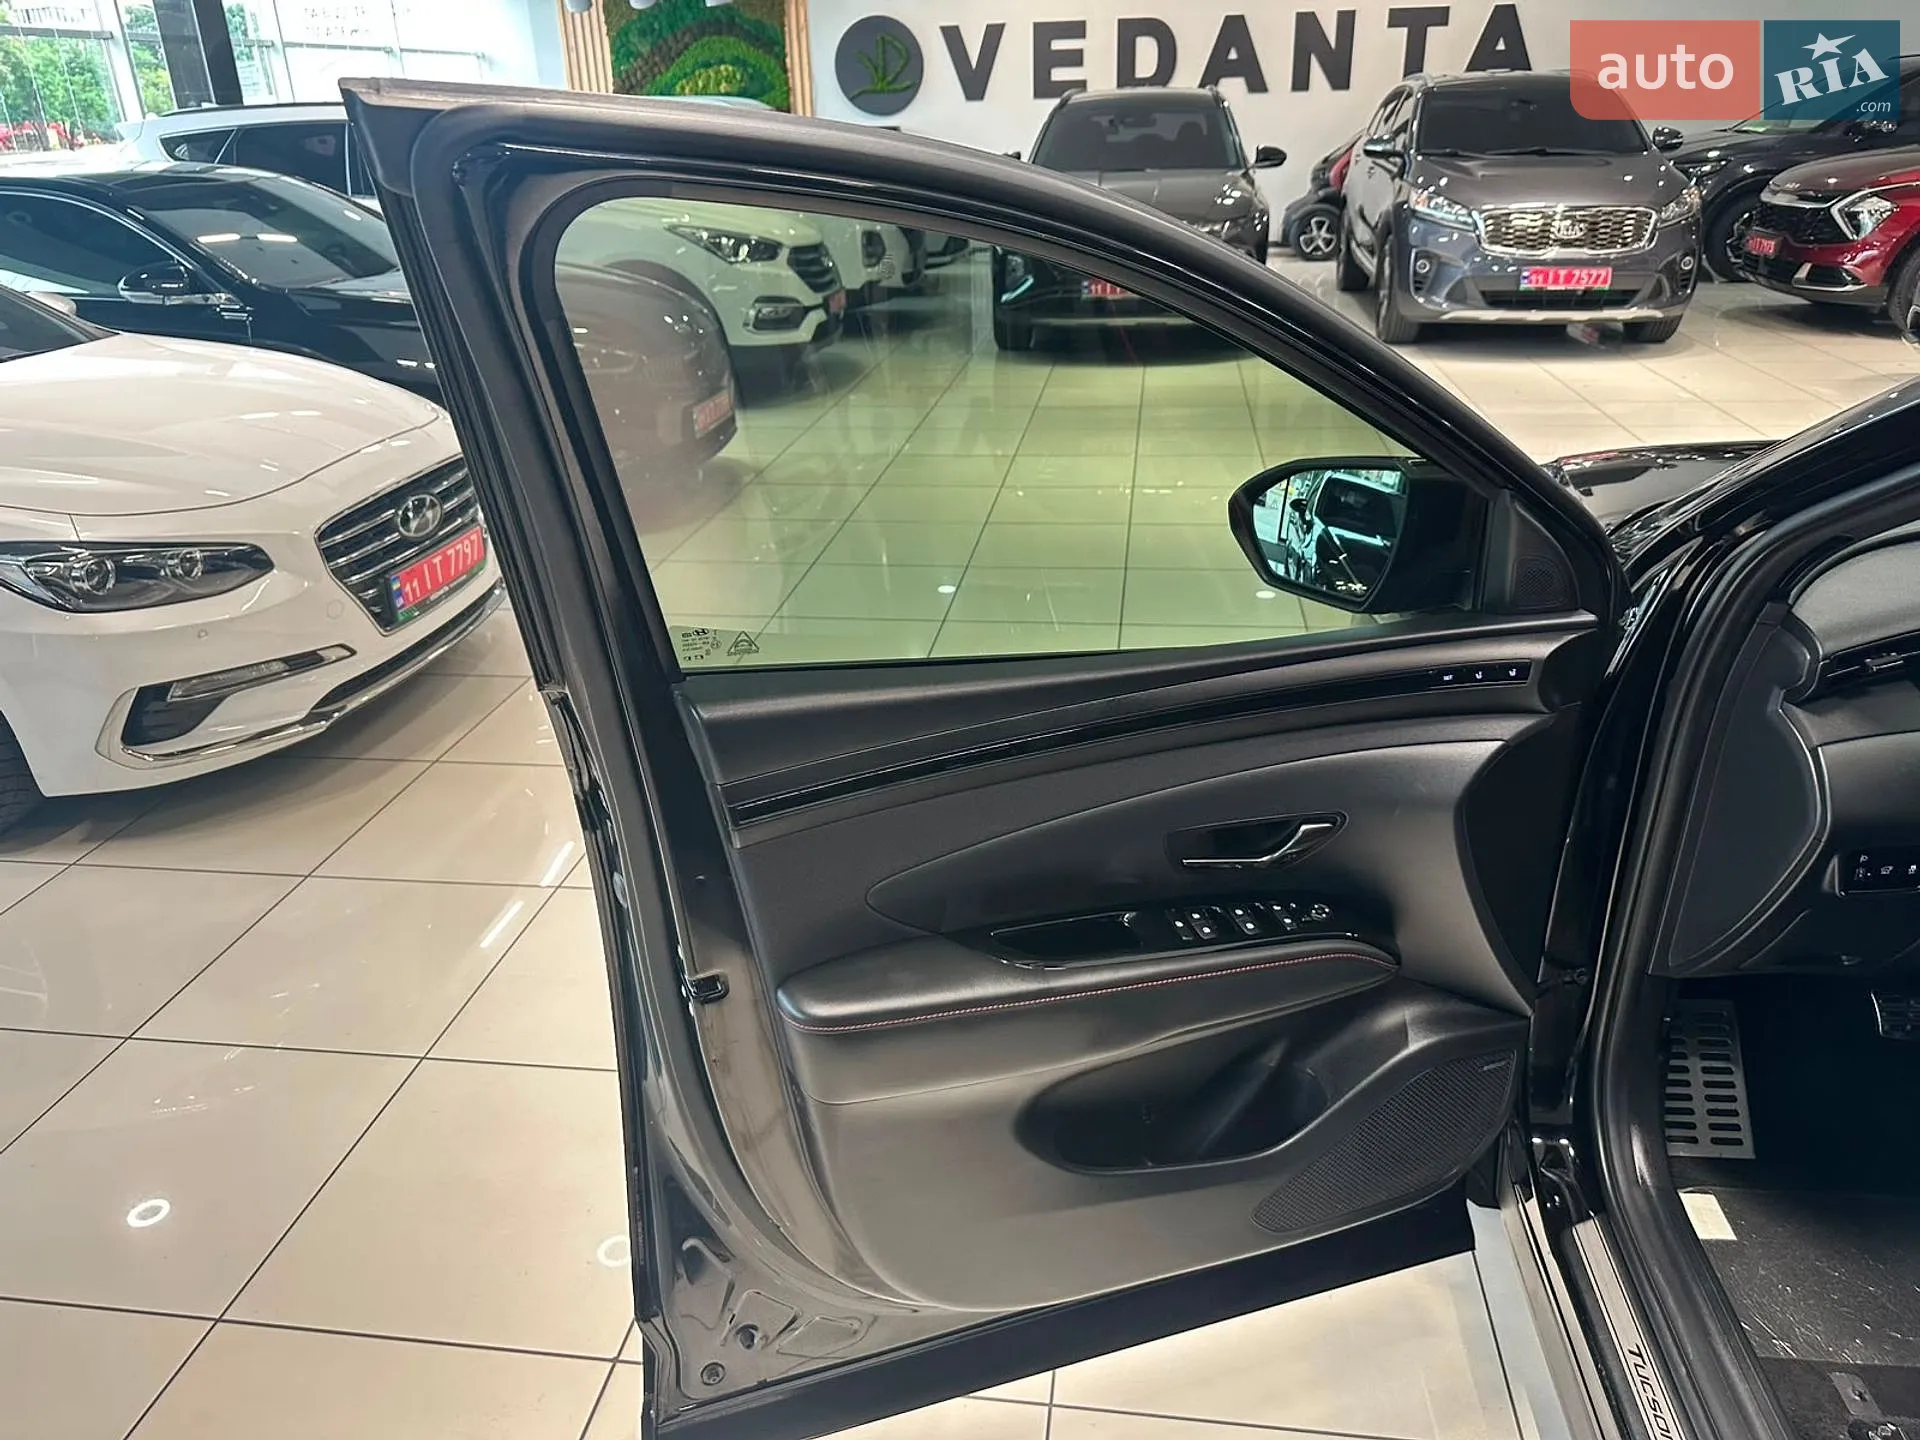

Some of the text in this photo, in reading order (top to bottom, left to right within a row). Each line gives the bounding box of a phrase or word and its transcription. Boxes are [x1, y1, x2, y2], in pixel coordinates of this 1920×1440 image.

[939, 3, 1533, 102] VEDANTA
[1530, 273, 1544, 285] 11
[1571, 269, 1608, 286] 7577
[405, 577, 421, 602] 11
[423, 555, 443, 591] IT
[446, 532, 479, 577] 7797
